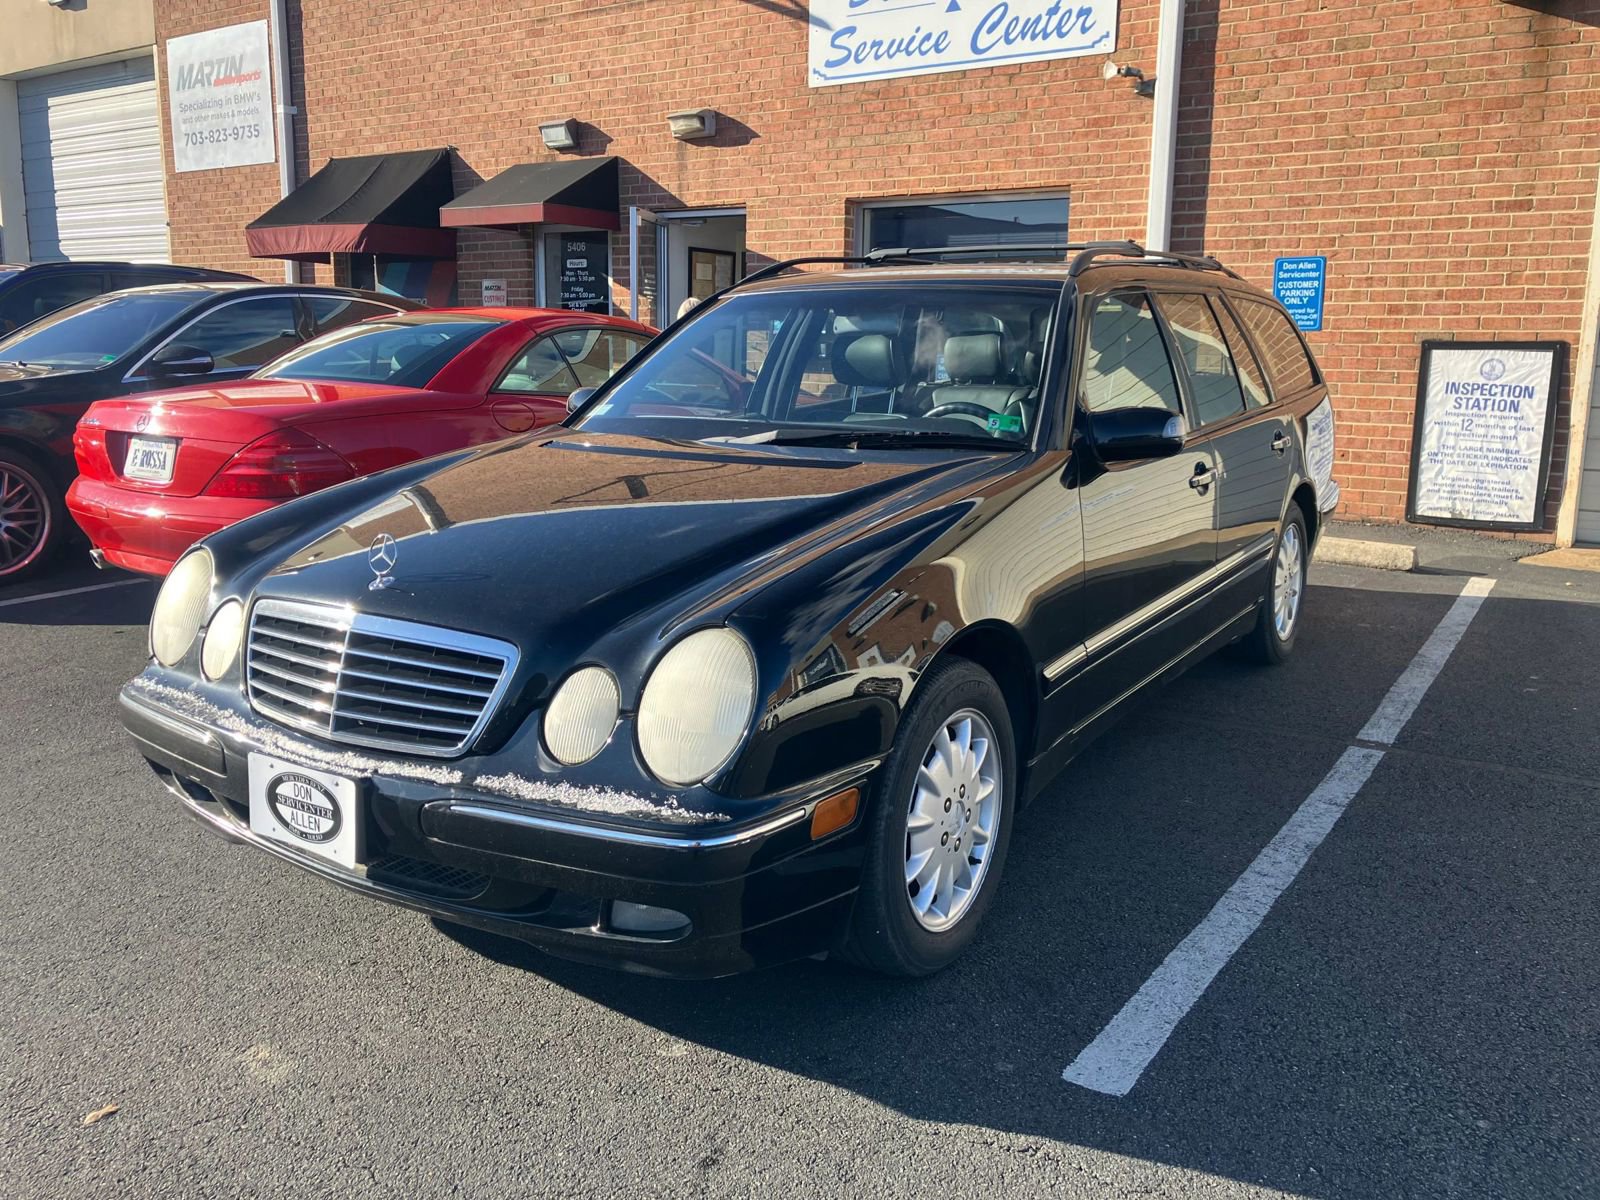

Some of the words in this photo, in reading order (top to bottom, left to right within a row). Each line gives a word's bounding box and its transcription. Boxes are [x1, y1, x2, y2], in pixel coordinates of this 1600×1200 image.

[824, 25, 952, 69] Service
[970, 0, 1097, 55] Center
[176, 54, 244, 91] MARTIN
[179, 99, 222, 114] Specializing
[224, 96, 232, 105] in
[234, 91, 262, 104] BMW's
[182, 116, 194, 124] and
[194, 114, 210, 123] other
[211, 111, 230, 120] makes
[231, 109, 236, 118] &
[236, 106, 260, 116] models
[184, 124, 260, 147] 703-823-9735
[568, 242, 586, 252] 5406
[1445, 382, 1535, 400] INSPECTION
[1453, 396, 1520, 413] STATION
[1445, 410, 1487, 419] Inspection
[1490, 412, 1524, 421] required
[1461, 418, 1472, 432] 12
[1446, 430, 1488, 439] inspection
[131, 449, 140, 467] E
[1480, 462, 1528, 471] EXPIRATION
[1472, 478, 1511, 486] registered
[293, 783, 312, 802] DON
[277, 794, 333, 819] SERVICENTER
[290, 810, 320, 832] ALLEN
